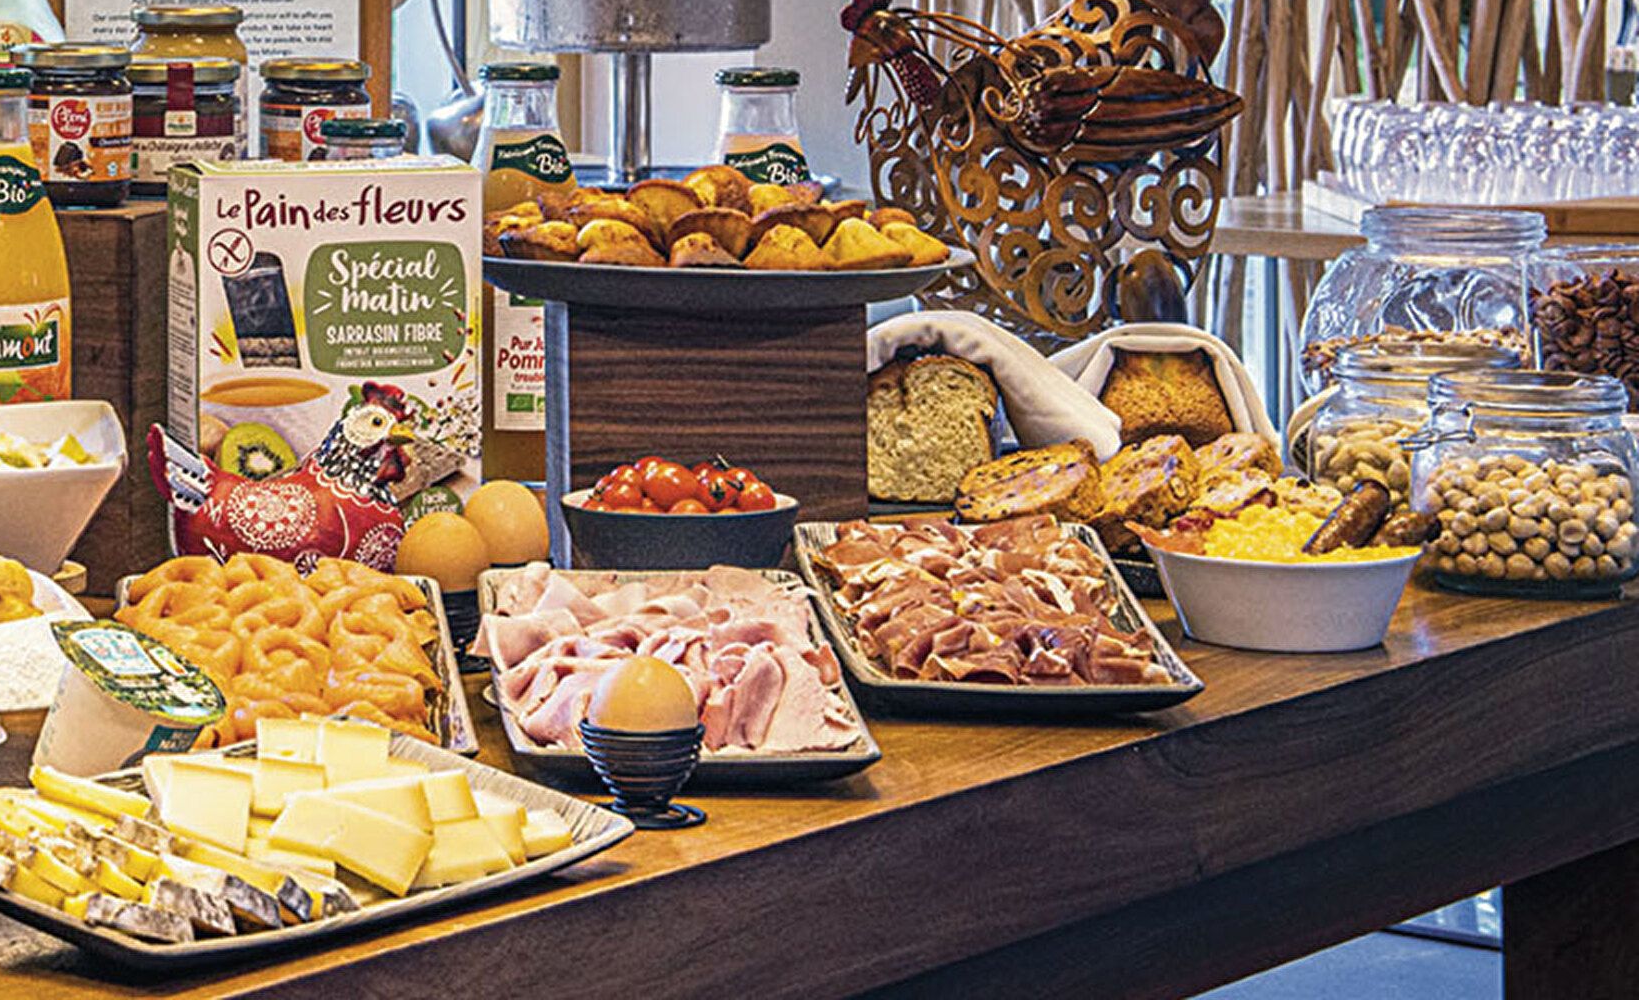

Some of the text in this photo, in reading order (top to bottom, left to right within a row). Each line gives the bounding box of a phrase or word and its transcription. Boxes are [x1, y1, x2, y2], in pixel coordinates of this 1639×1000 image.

[535, 153, 564, 175] Bio
[766, 162, 798, 184] Bio
[217, 184, 468, 230] Le Pain des fleurs
[328, 248, 441, 288] Spécial
[326, 322, 443, 344] SARRASIN FIBRE
[510, 336, 533, 350] Pur
